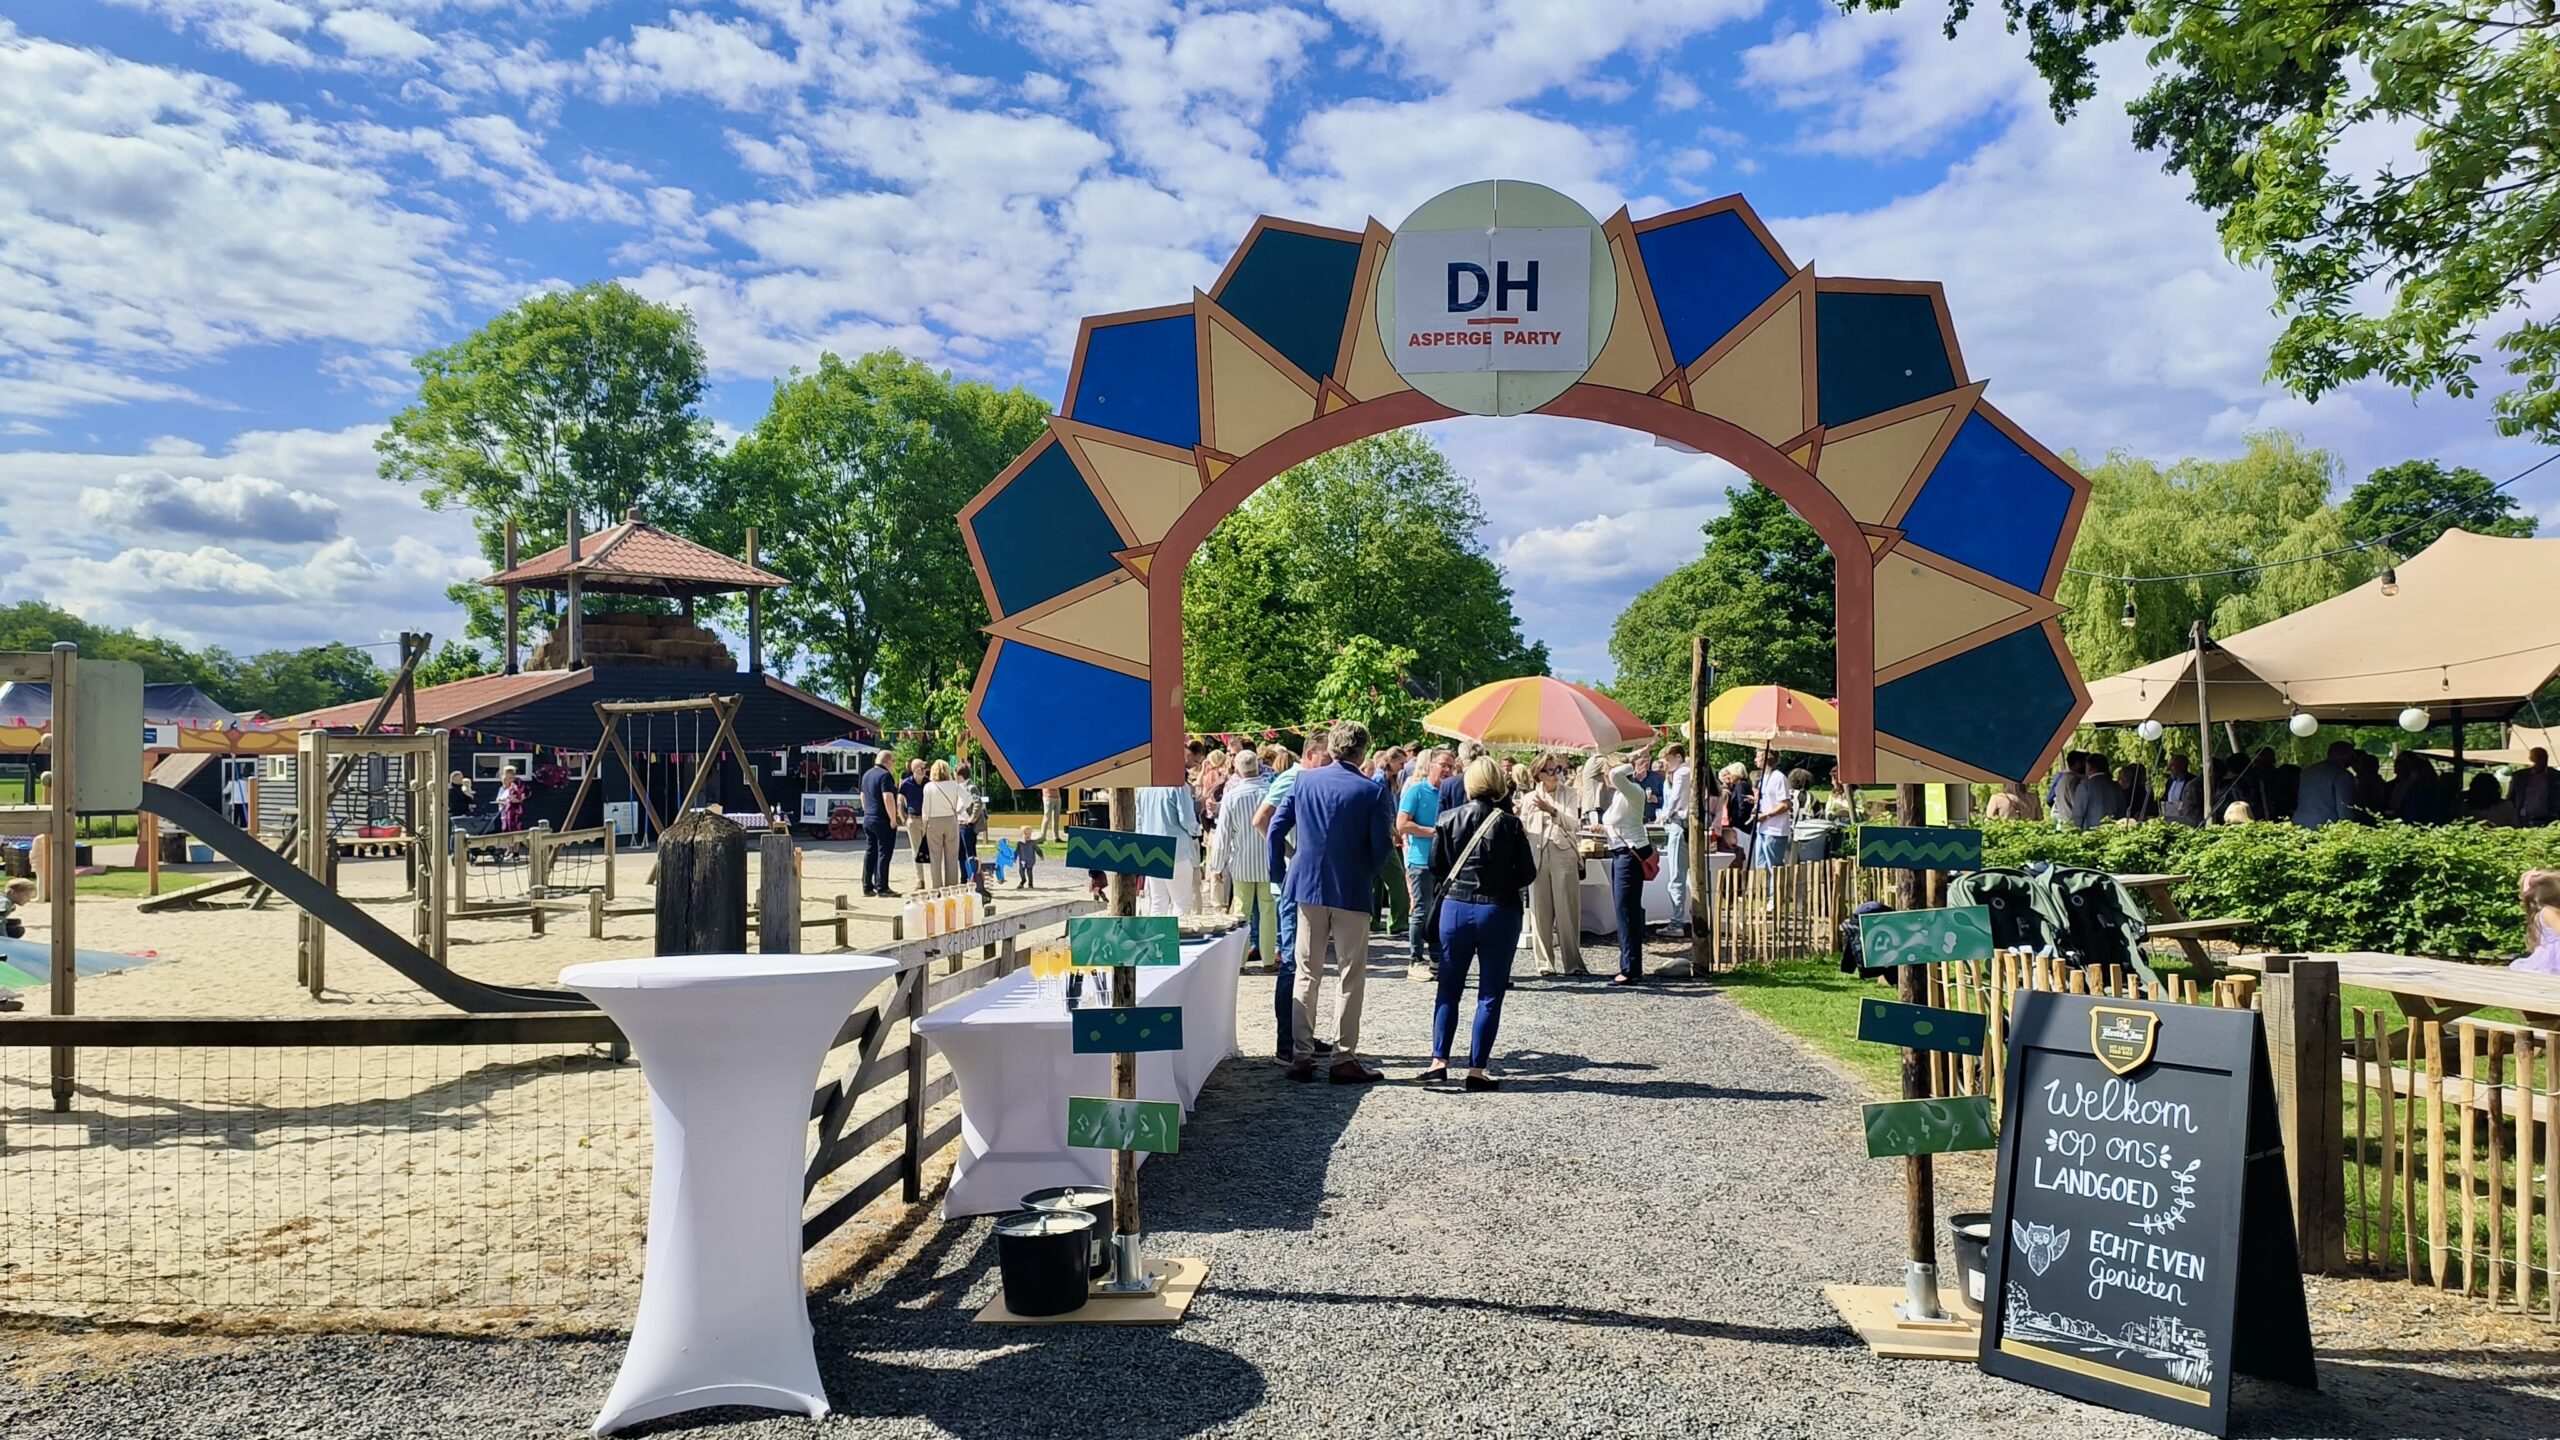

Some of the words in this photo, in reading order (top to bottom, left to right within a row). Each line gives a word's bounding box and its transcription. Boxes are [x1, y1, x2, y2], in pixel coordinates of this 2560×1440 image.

[1447, 260, 1540, 313] DH
[1408, 331, 1492, 347] ASPERGE
[1503, 330, 1562, 345] PARTY
[2043, 1077, 2199, 1134] Welkom
[2058, 1129, 2097, 1167] op
[2105, 1137, 2157, 1169] ons
[2034, 1156, 2159, 1209] LANDGOED
[2088, 1229, 2145, 1264] ECHT
[2146, 1243, 2206, 1282] EVEN
[2088, 1256, 2188, 1307] Genieten
